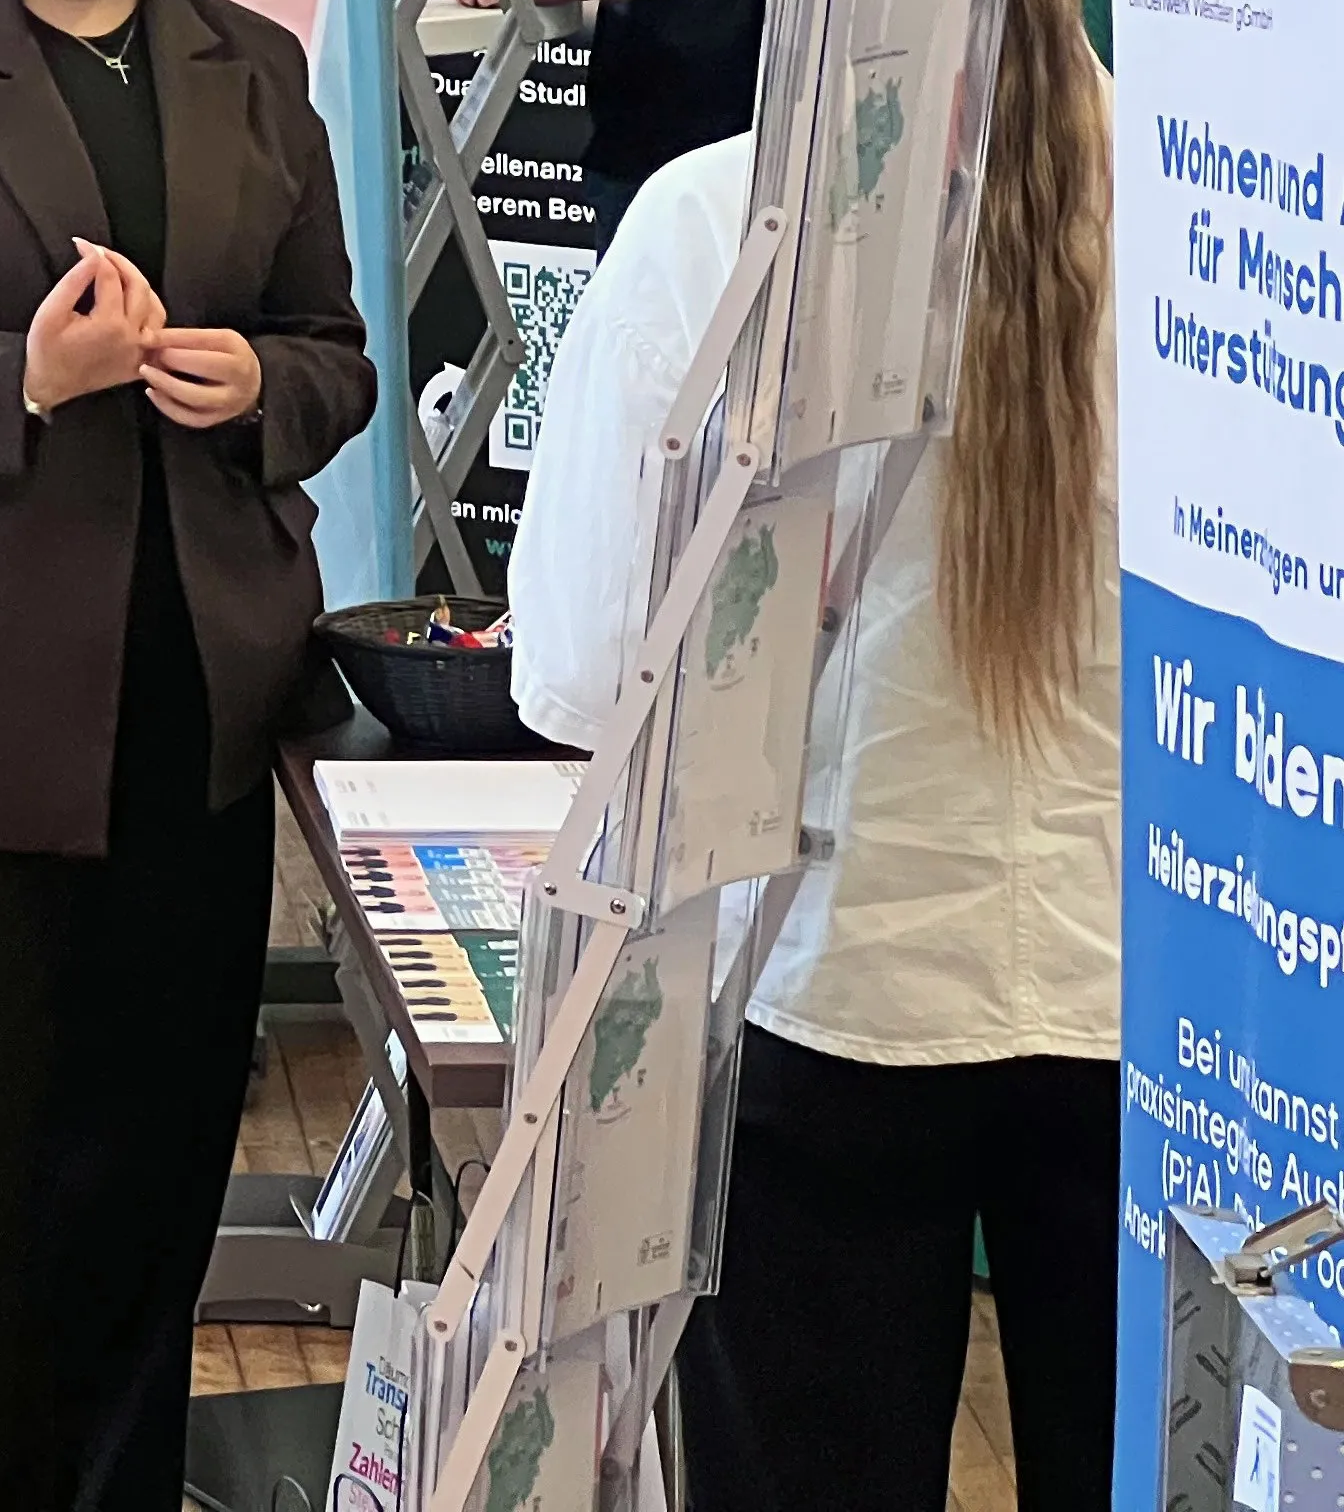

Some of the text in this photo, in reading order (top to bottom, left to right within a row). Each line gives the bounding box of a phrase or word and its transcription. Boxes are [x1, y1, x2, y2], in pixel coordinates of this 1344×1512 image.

[472, 194, 541, 218] erem
[1157, 114, 1324, 222] Wohnen und
[1189, 207, 1343, 322] für Mensch
[1153, 654, 1215, 766] Wir
[1178, 1016, 1221, 1081] Bei
